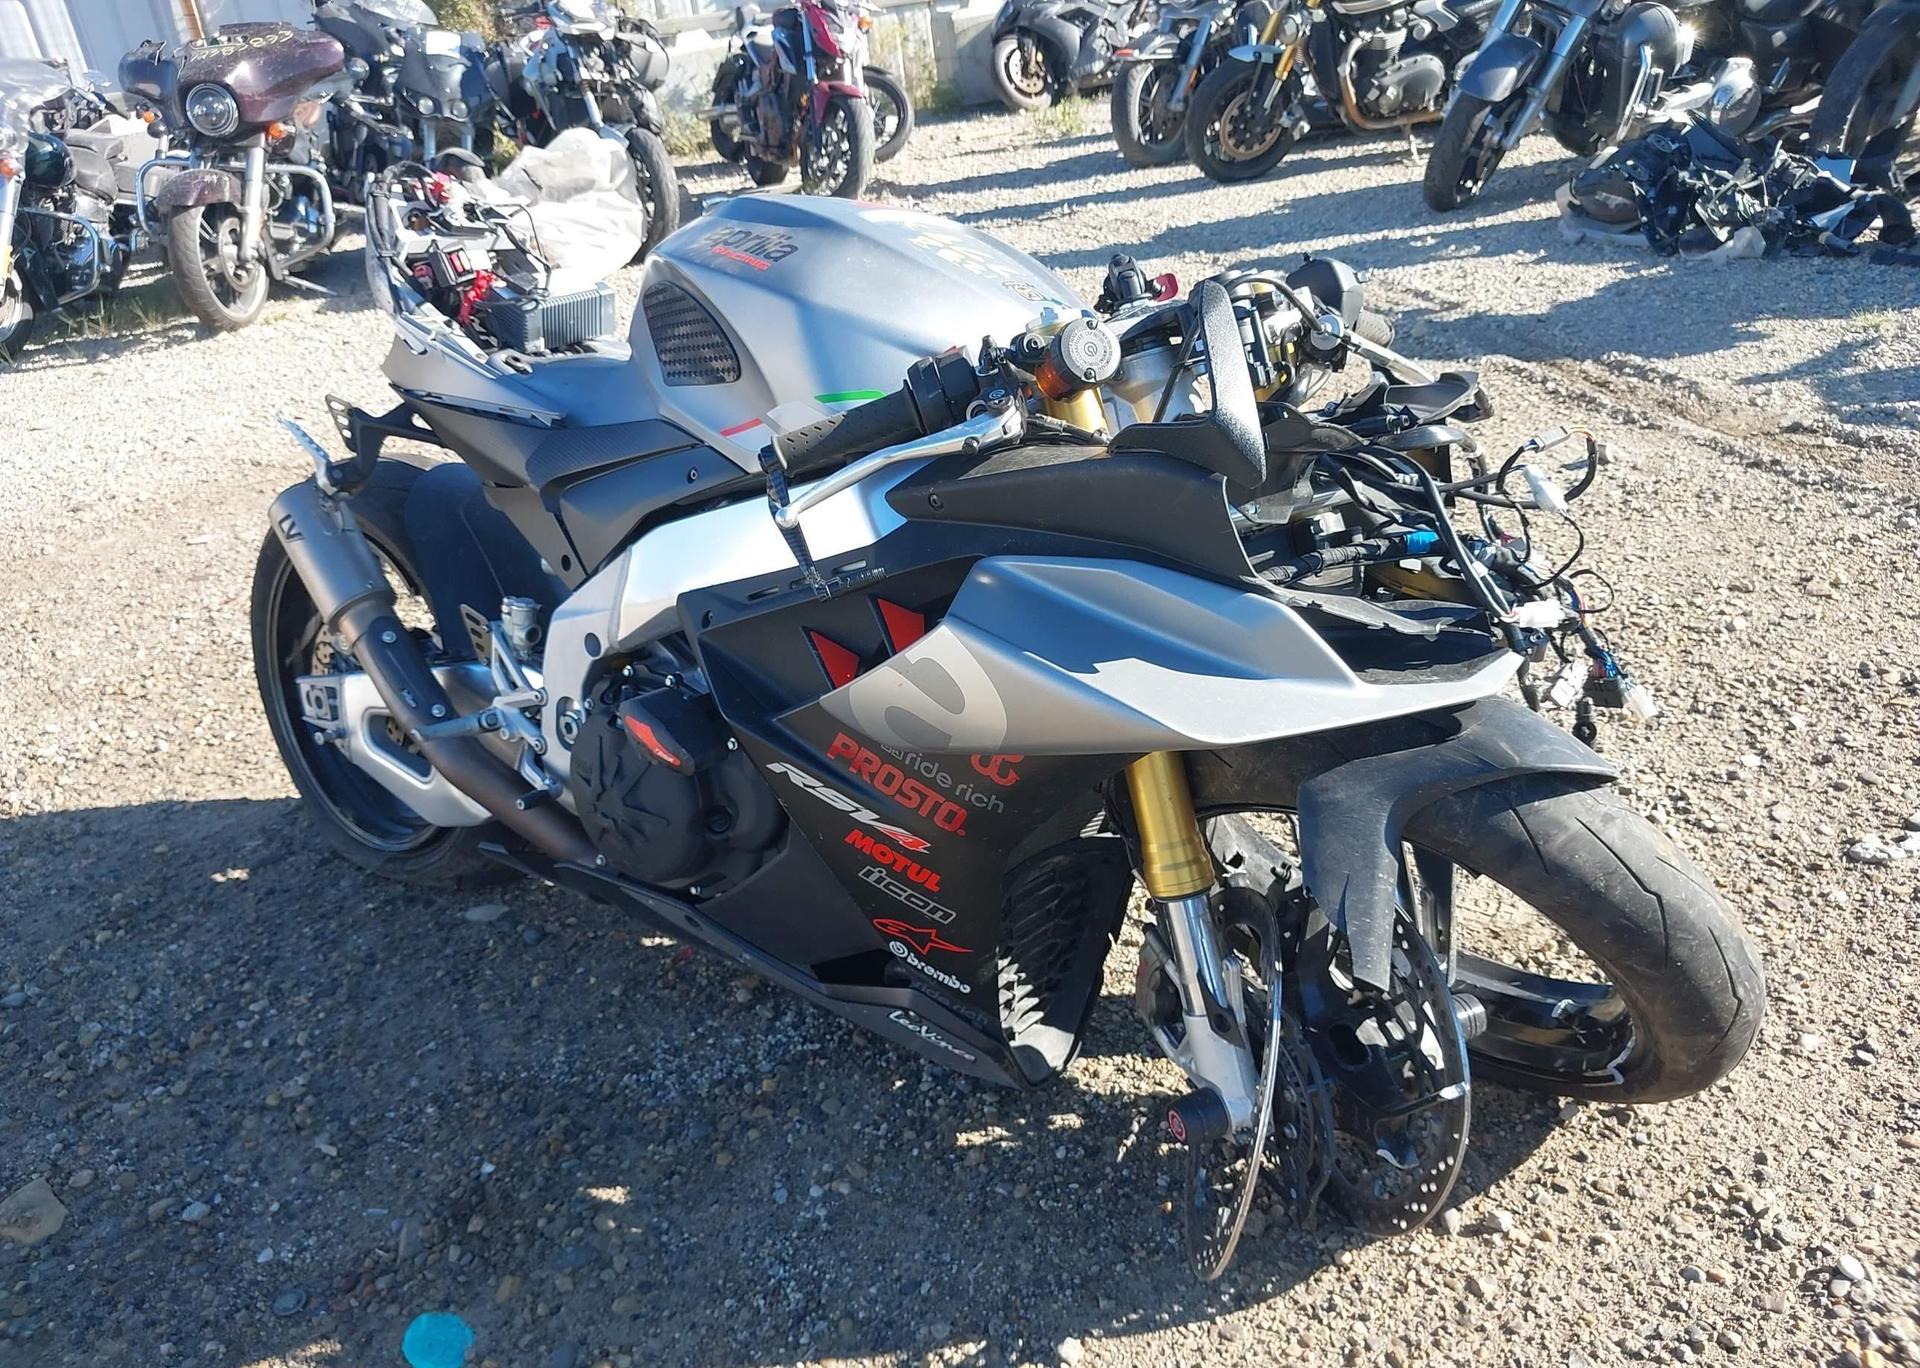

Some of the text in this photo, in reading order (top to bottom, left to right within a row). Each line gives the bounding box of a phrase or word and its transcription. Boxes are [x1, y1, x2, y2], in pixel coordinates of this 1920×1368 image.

[278, 513, 304, 542] LV
[765, 761, 932, 853] RSV4
[904, 751, 953, 788] ride
[954, 781, 1005, 814] rich
[843, 828, 941, 893] MOTUL
[906, 953, 972, 994] brembo
